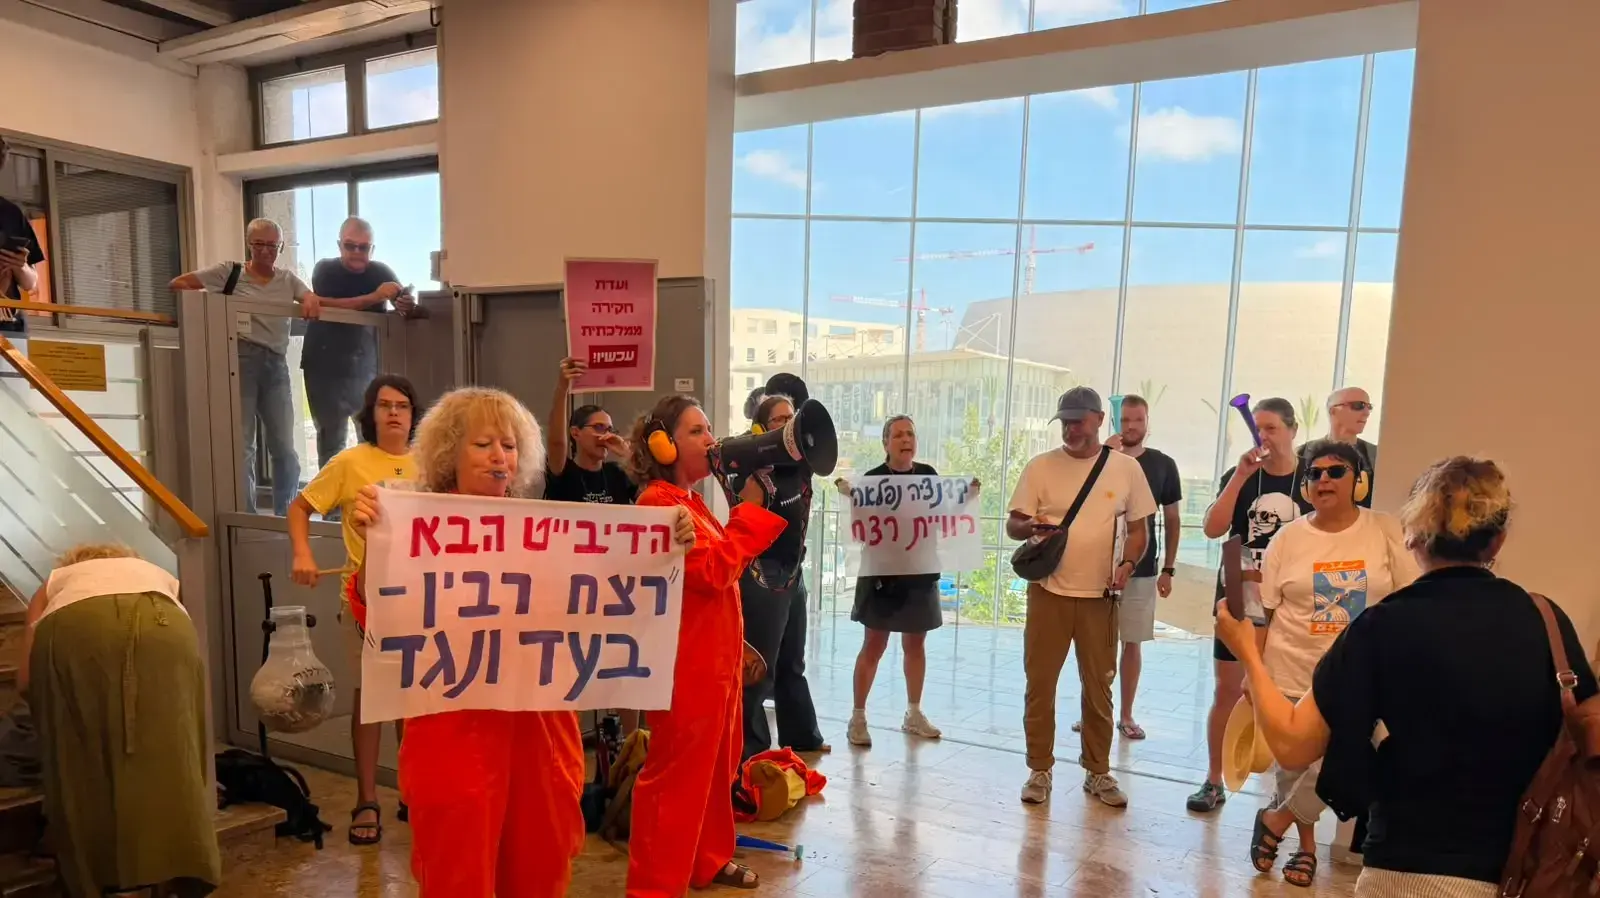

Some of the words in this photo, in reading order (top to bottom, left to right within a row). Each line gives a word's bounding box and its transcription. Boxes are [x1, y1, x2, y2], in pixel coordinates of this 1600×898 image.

[595, 279, 628, 290] ועדת
[591, 302, 634, 315] חקירה
[580, 324, 642, 337] ממלכתית
[592, 350, 635, 363] עכשיו!
[849, 478, 902, 511] נפלאה
[907, 477, 968, 509] קדנציה
[409, 514, 505, 558] הבא
[523, 515, 670, 555] הדיבייט
[851, 514, 899, 546] רצח
[422, 570, 532, 629] רבין
[518, 629, 651, 702] בעד
